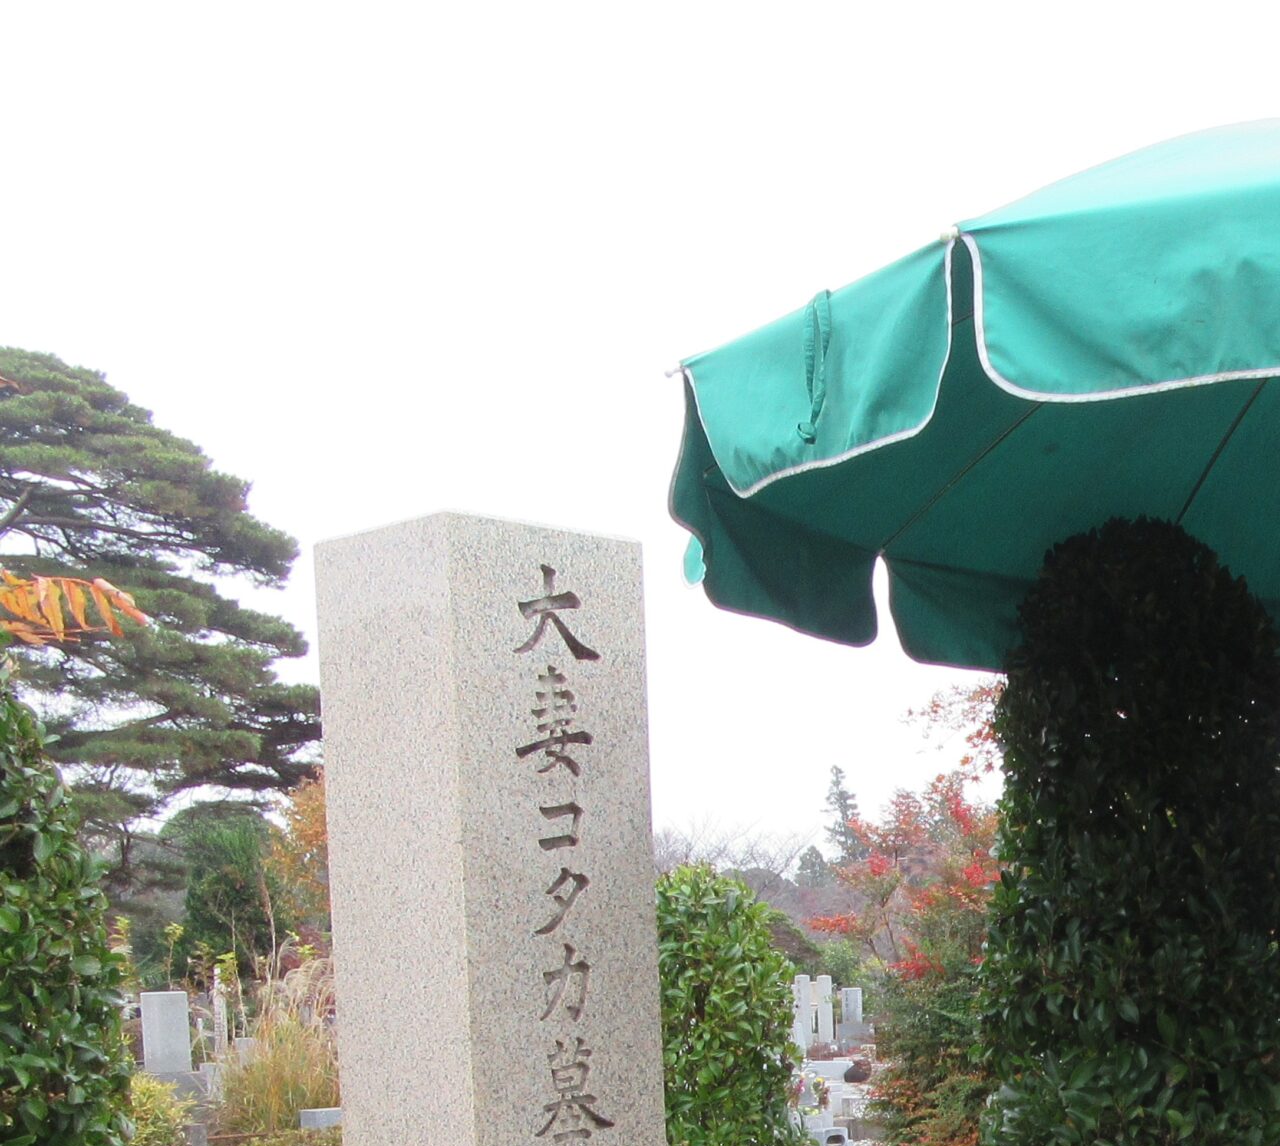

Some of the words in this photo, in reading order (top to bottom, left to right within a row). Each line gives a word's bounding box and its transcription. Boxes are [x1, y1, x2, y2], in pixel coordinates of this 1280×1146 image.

[513, 563, 615, 1145] 大妻コタカ墓
